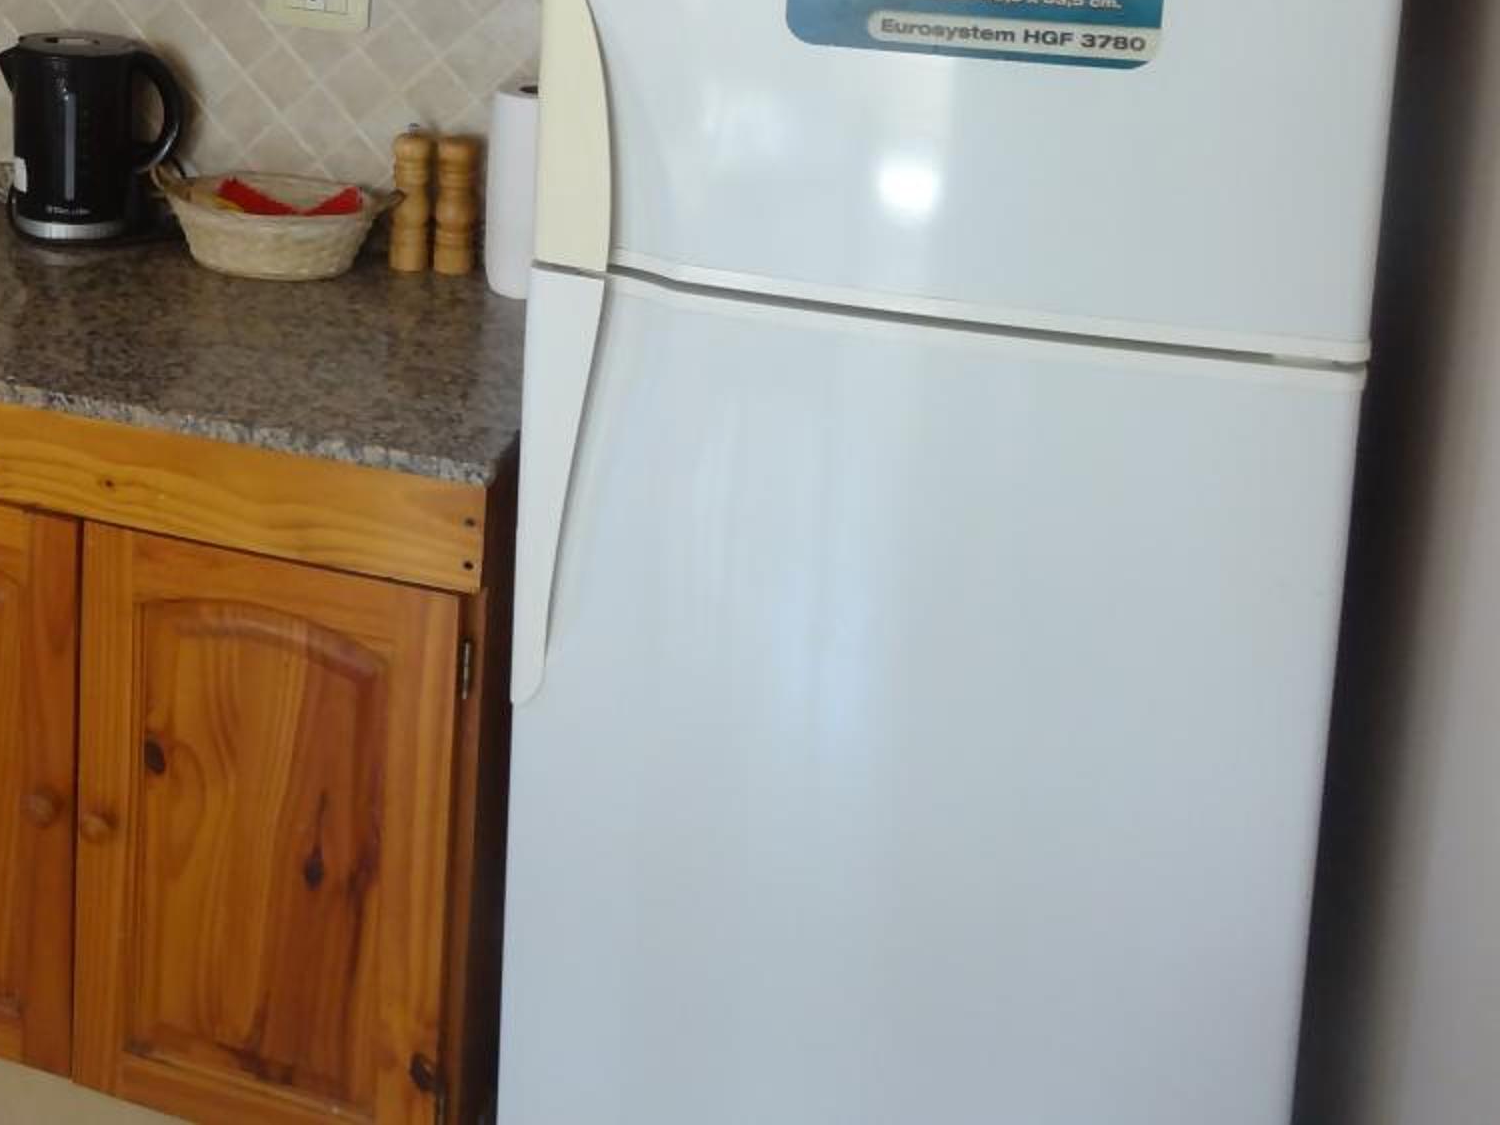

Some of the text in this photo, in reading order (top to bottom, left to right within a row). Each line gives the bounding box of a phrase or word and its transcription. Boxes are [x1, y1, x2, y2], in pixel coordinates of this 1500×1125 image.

[881, 18, 1146, 52] Eurosystem HGF 3780
